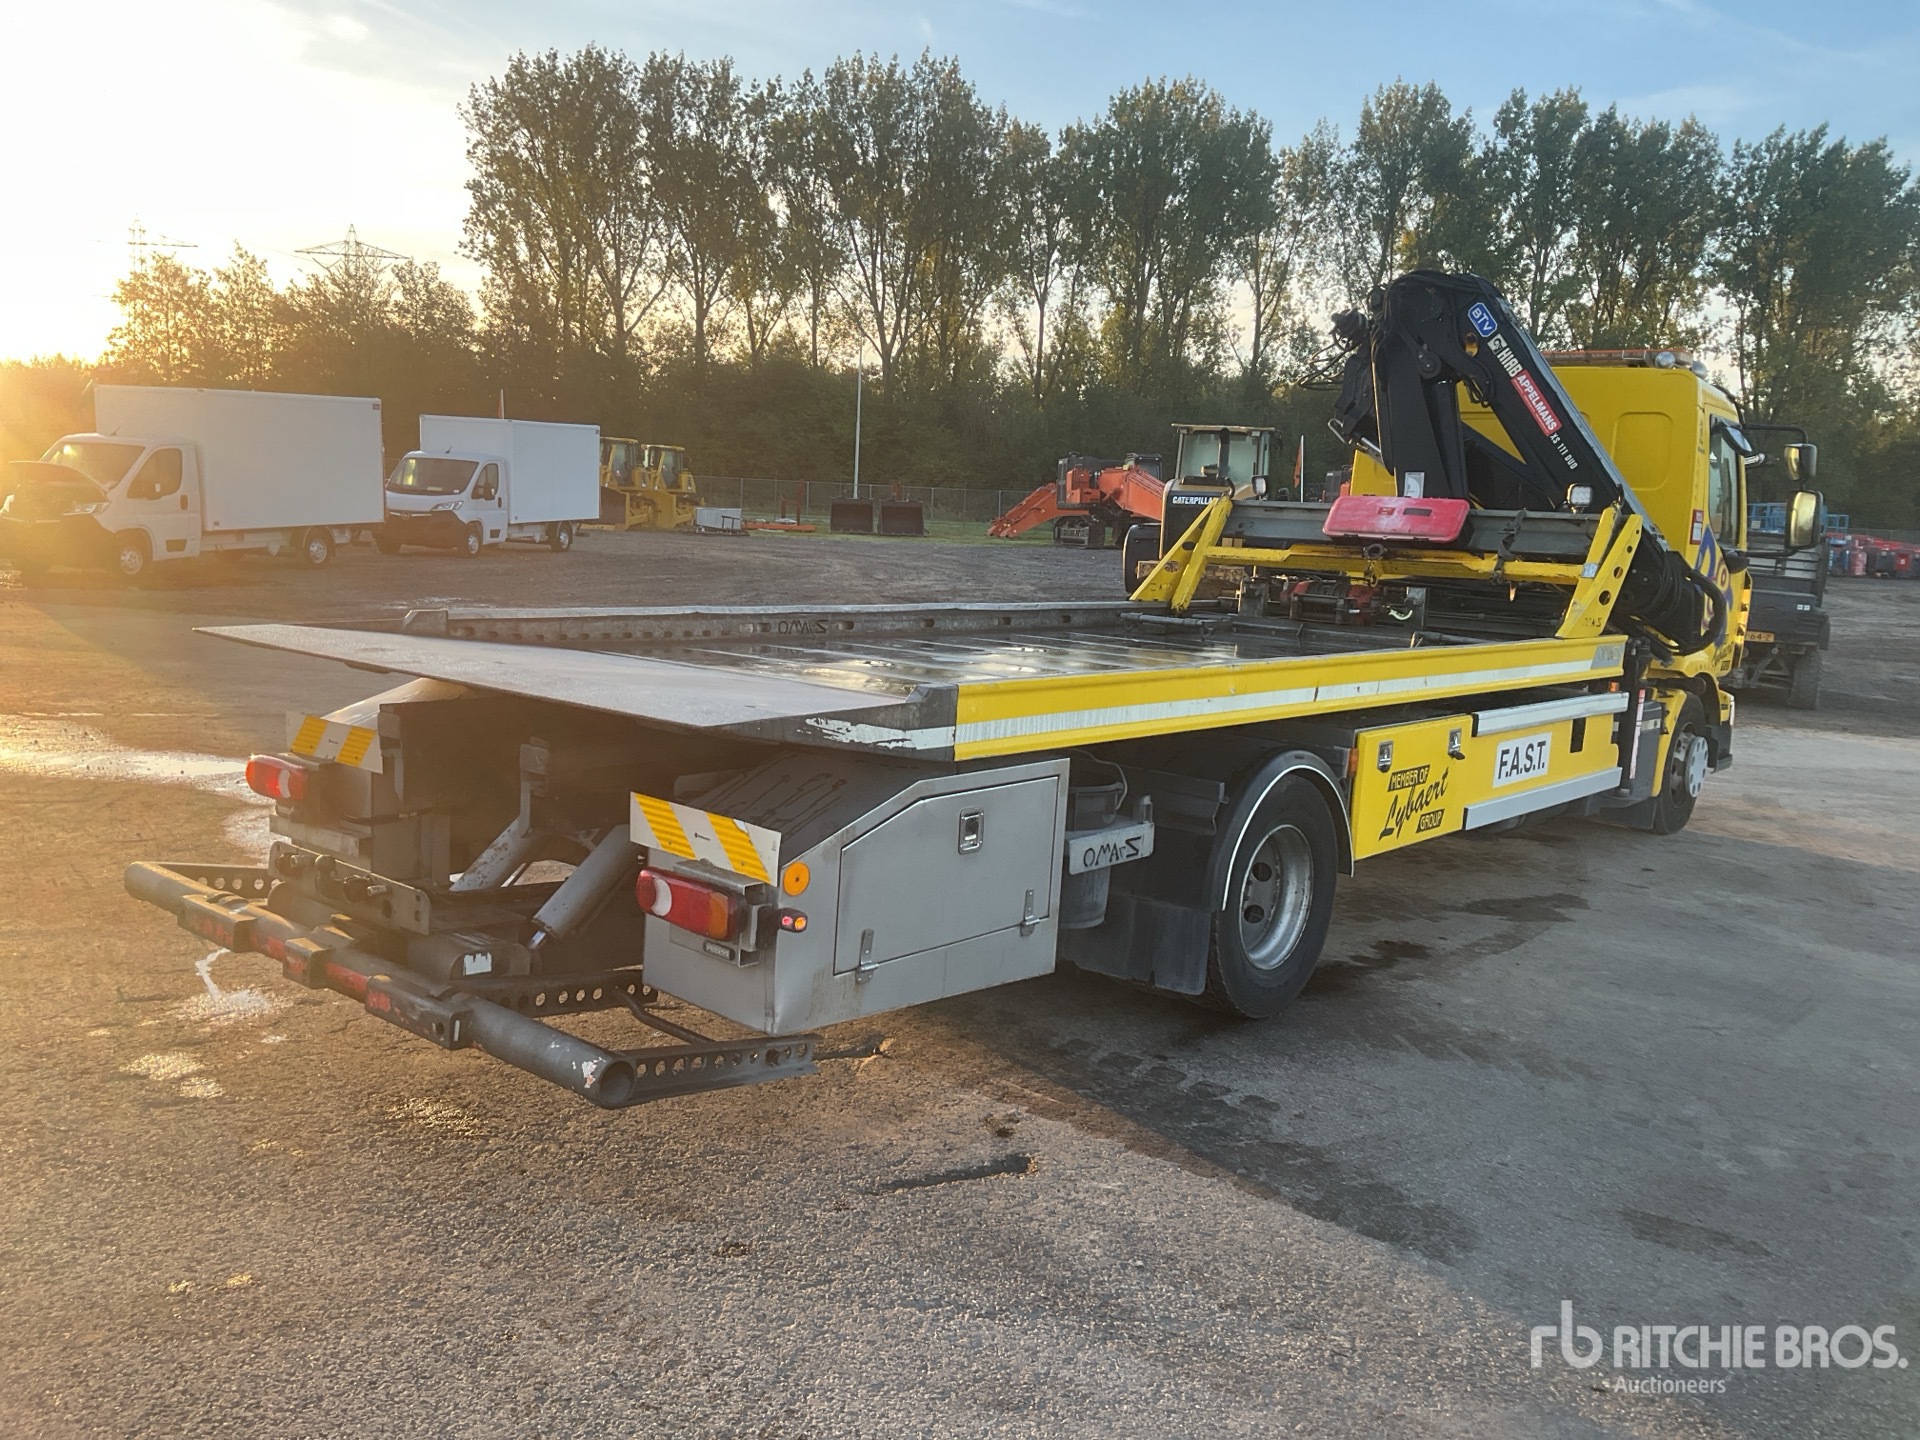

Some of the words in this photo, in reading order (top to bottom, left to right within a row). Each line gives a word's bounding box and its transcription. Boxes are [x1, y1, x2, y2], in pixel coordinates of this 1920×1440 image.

[1472, 307, 1493, 332] BTV
[1497, 345, 1523, 378] HIAB
[1517, 374, 1558, 432] APPELMANS
[1550, 432, 1560, 444] XS
[1564, 453, 1579, 470] DUO
[1172, 496, 1215, 505] CATERPILLA
[1498, 741, 1547, 779] F.A.S.T.
[1391, 769, 1419, 789] MEMBER
[1419, 767, 1429, 783] OF
[1379, 766, 1450, 841] Lybaert
[1420, 811, 1442, 831] GROUP
